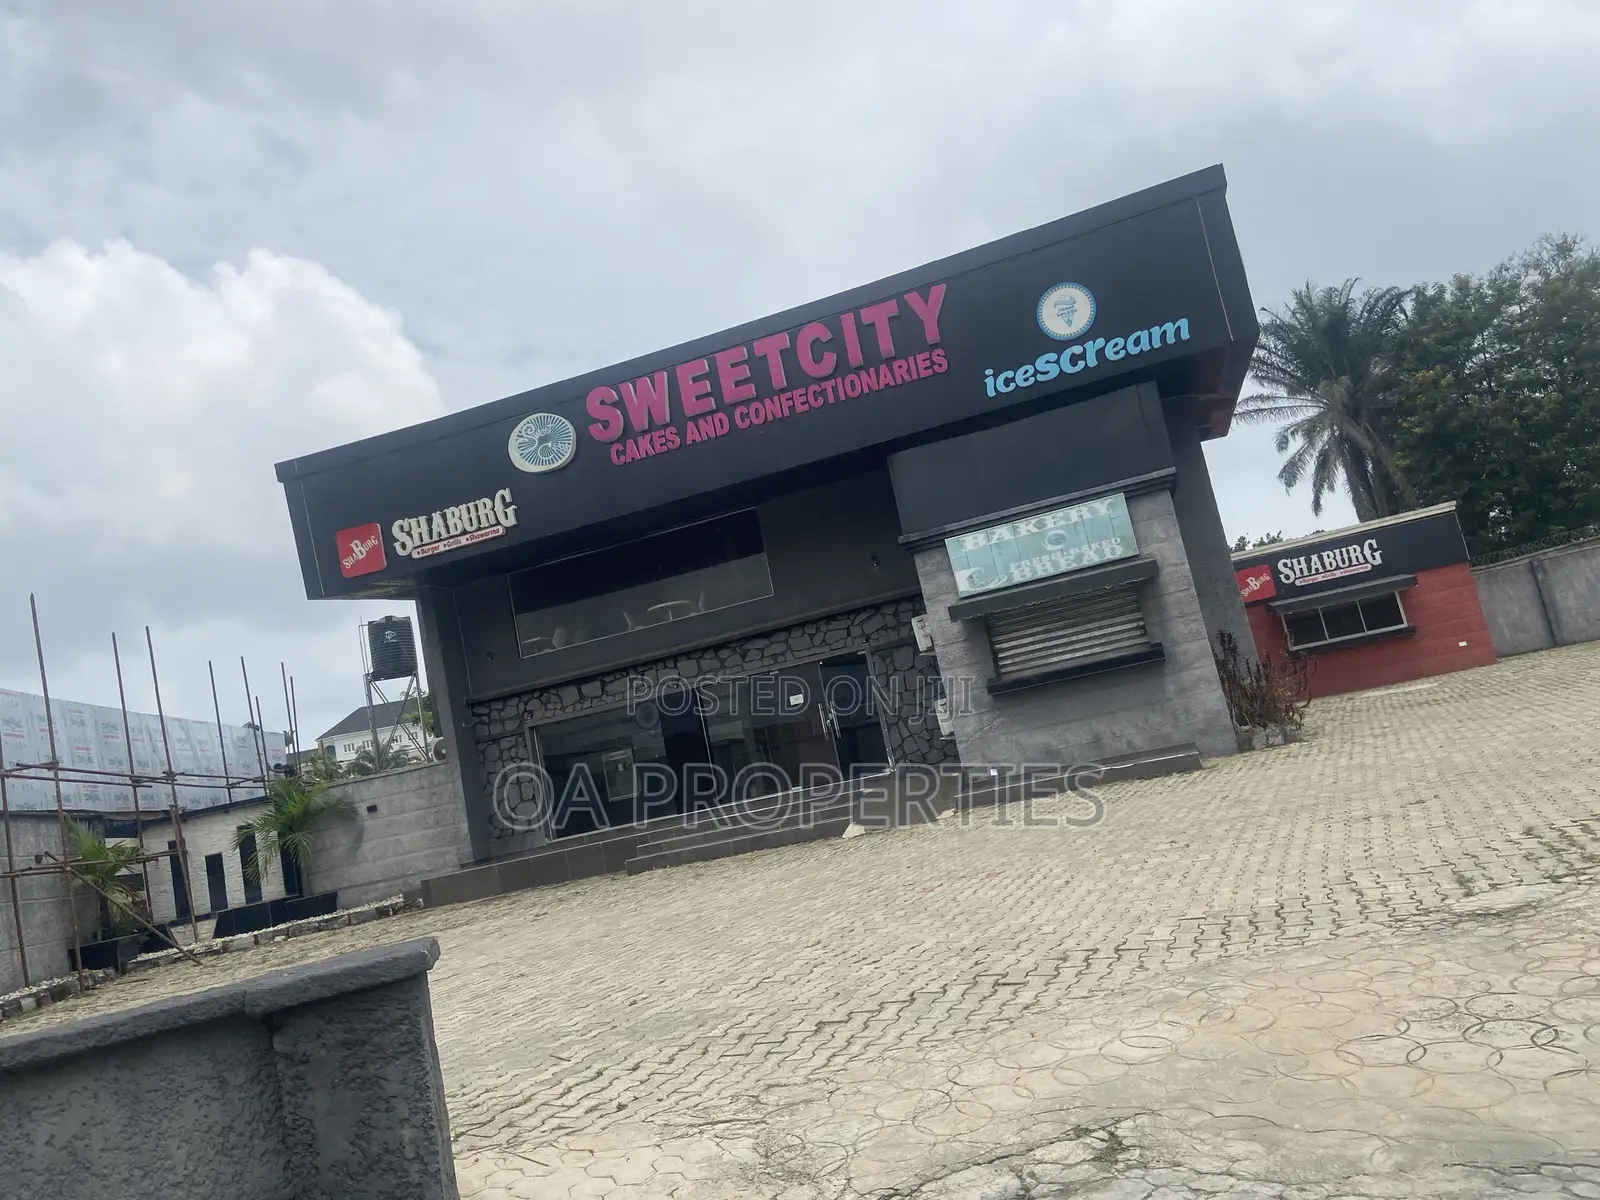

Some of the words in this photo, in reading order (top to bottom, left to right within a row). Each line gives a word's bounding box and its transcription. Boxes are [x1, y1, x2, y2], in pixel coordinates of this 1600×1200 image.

[585, 283, 947, 443] SWEETCITY
[610, 426, 681, 466] CAKES
[686, 412, 730, 445] AND
[734, 348, 949, 430] CONFECTIONARIES
[391, 487, 518, 557] SHABURG
[420, 544, 440, 556] Burger
[447, 538, 462, 549] Grills
[468, 527, 500, 542] Shawarma
[961, 498, 1114, 552] BAKERY
[1011, 544, 1124, 583] BREAD
[1277, 538, 1383, 585] SHABURG
